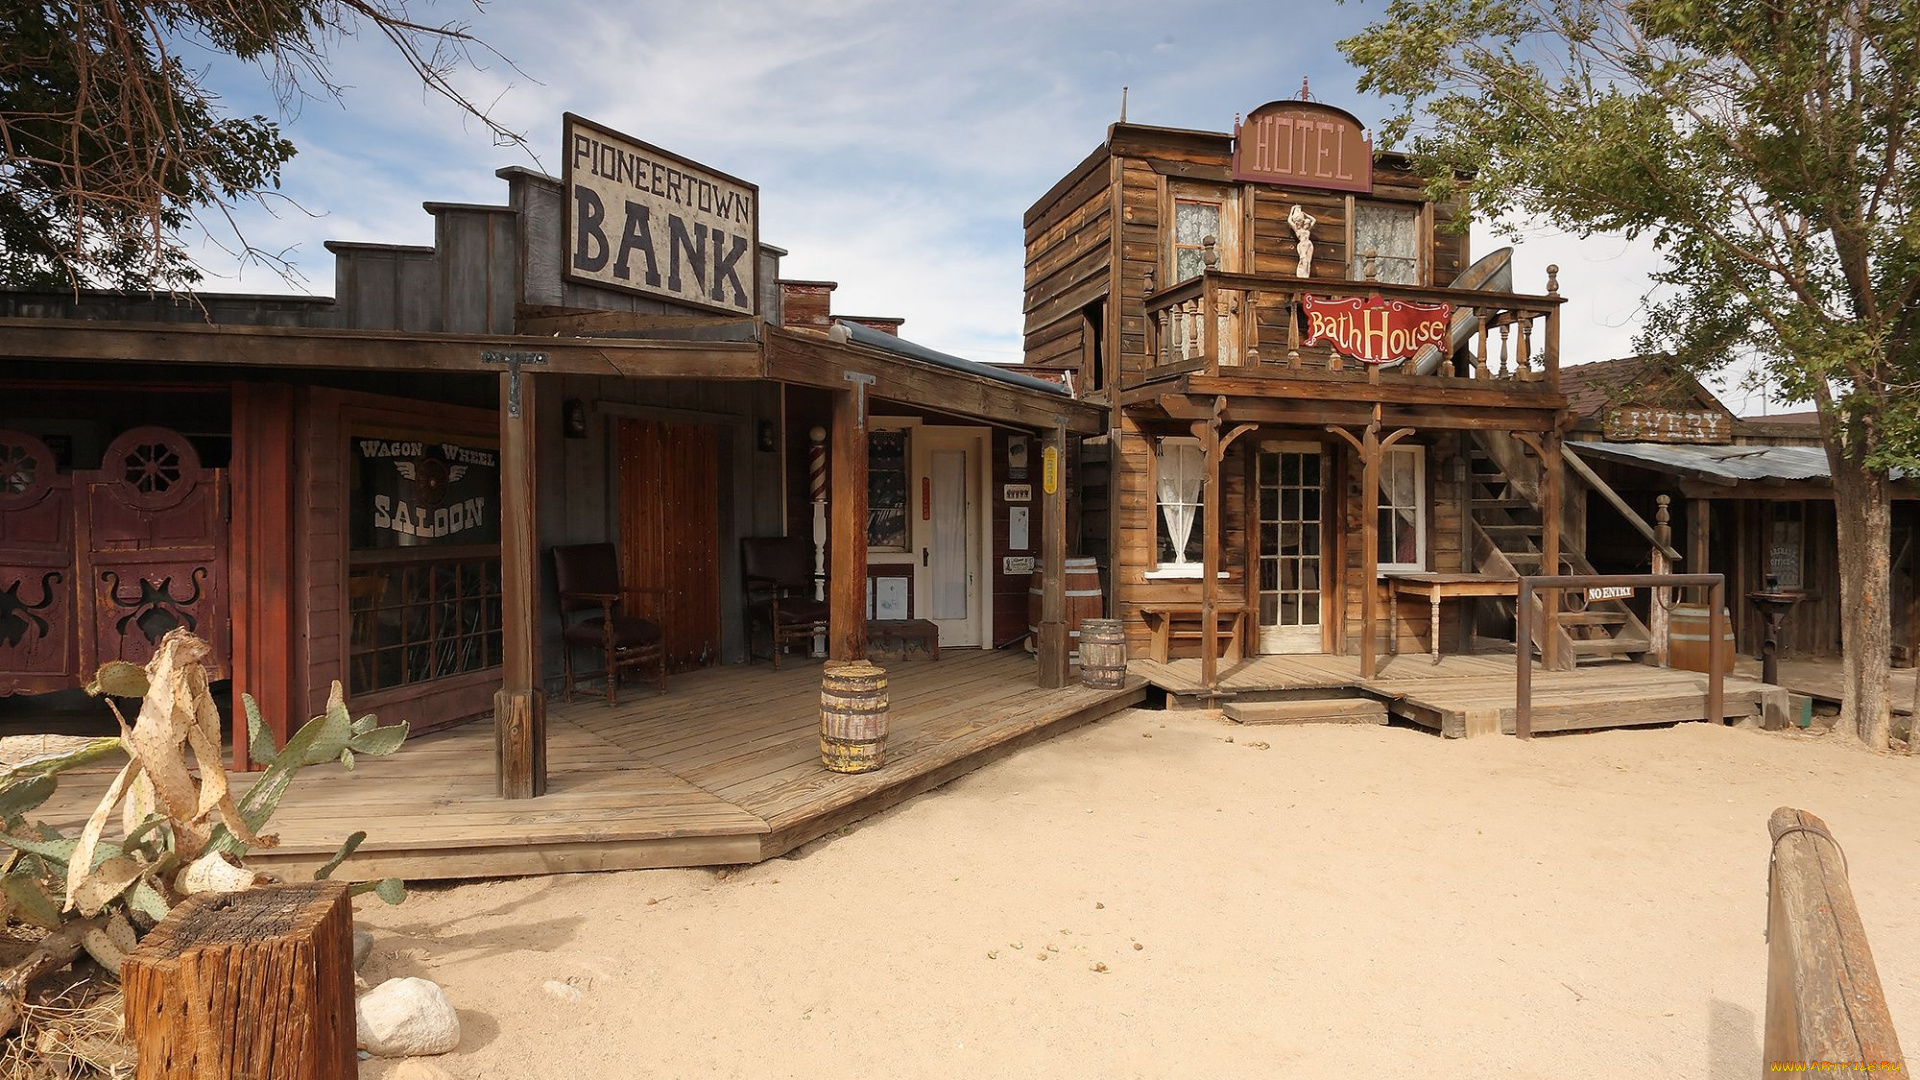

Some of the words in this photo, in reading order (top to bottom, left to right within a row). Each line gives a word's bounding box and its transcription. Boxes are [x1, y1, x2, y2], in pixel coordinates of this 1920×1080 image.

[1253, 115, 1353, 181] HOTEL
[573, 133, 749, 224] PIONEERTOWN
[573, 184, 748, 308] BANK
[360, 441, 423, 458] WAGON
[442, 443, 495, 467] WHEEL
[374, 494, 485, 538] SALOON
[1589, 588, 1602, 600] NO
[1602, 586, 1632, 598] ENTRY
